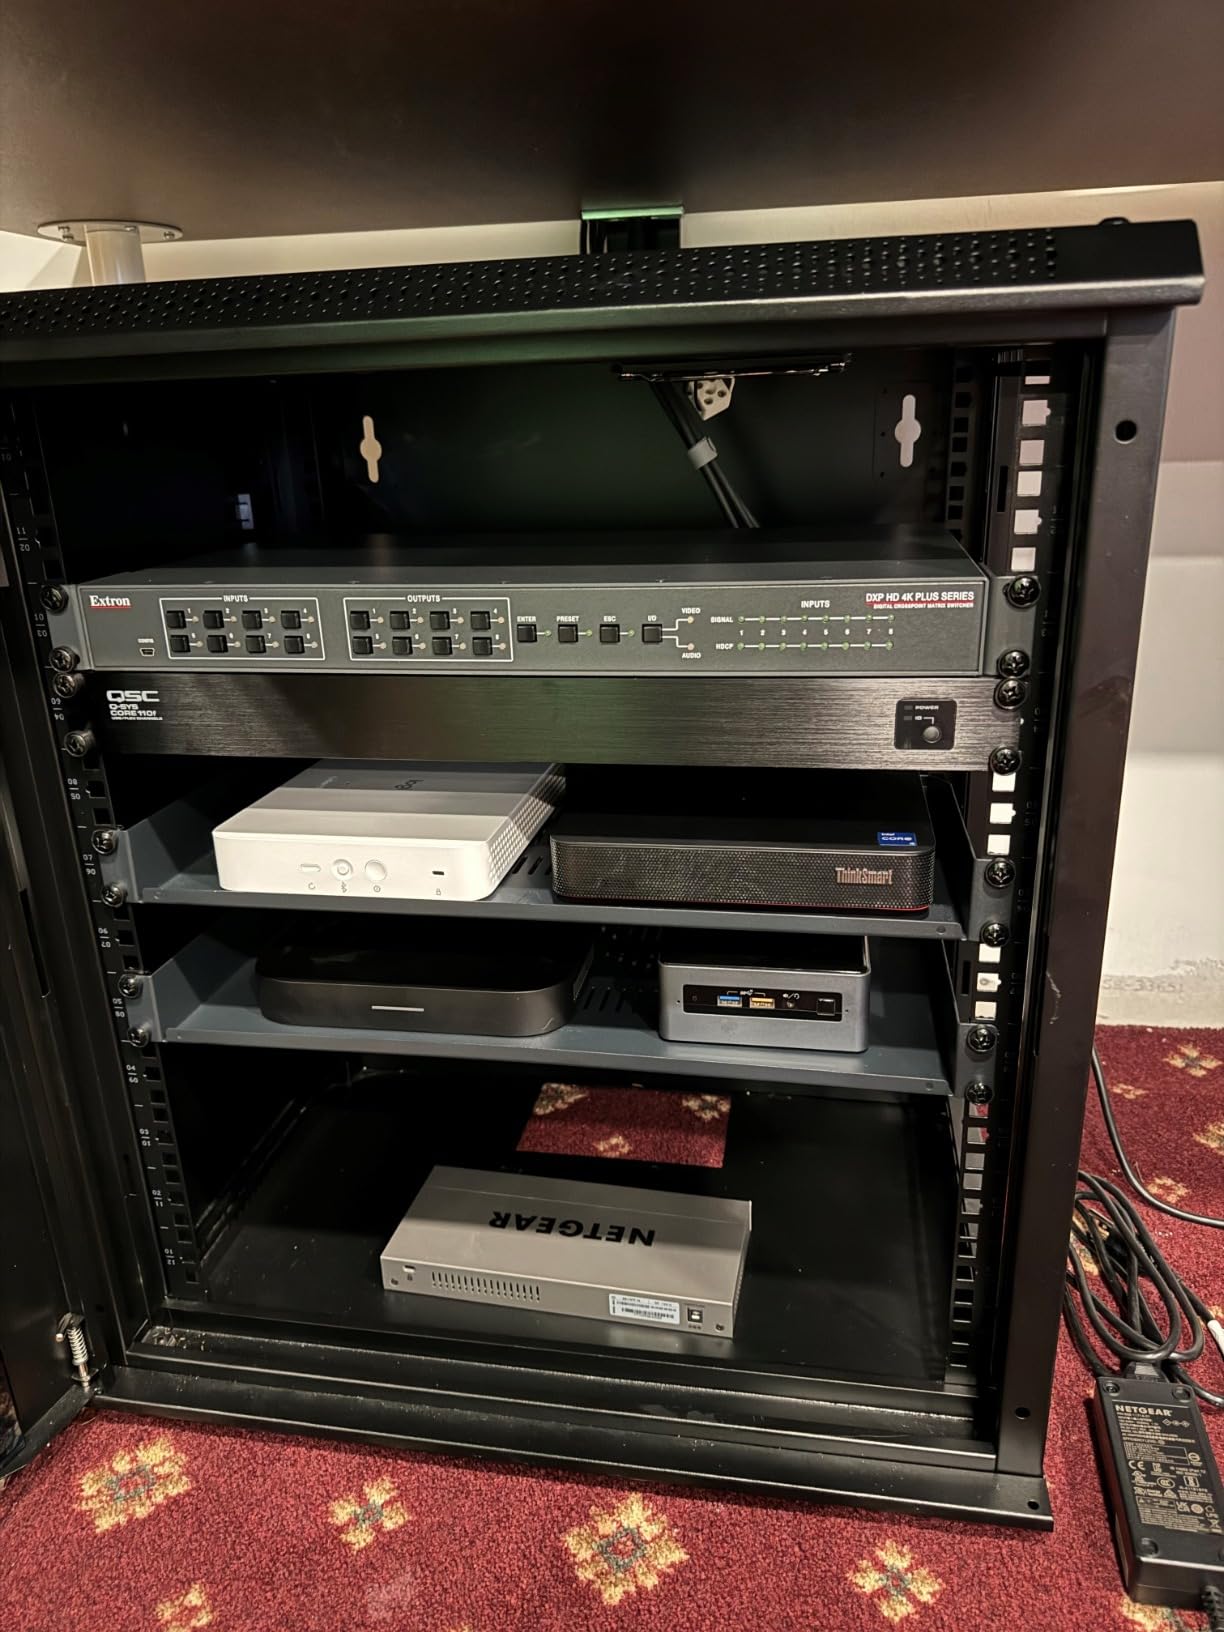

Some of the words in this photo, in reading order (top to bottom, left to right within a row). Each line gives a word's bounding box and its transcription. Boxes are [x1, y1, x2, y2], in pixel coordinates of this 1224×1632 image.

[89, 595, 131, 607] Extron
[223, 594, 249, 602] INPUTS
[407, 594, 441, 603] OUTPUTS
[865, 592, 884, 602] DXP
[885, 592, 900, 602] HD
[901, 592, 914, 602] 4K
[915, 591, 939, 601] PLUS
[940, 591, 974, 601] SERIES
[800, 600, 830, 609] INPUTS
[516, 615, 537, 623] ENTER
[556, 615, 579, 623] PRESET
[603, 615, 617, 623] ESC
[710, 616, 734, 624] SIGNAL
[845, 628, 850, 636] 6
[866, 628, 872, 636] 7
[682, 652, 701, 660] AUDIO
[106, 690, 160, 703] QSC
[835, 867, 893, 885] ThinkSmart
[488, 1210, 656, 1247] NETGEAR
[1114, 1404, 1172, 1417] NETGEAR
